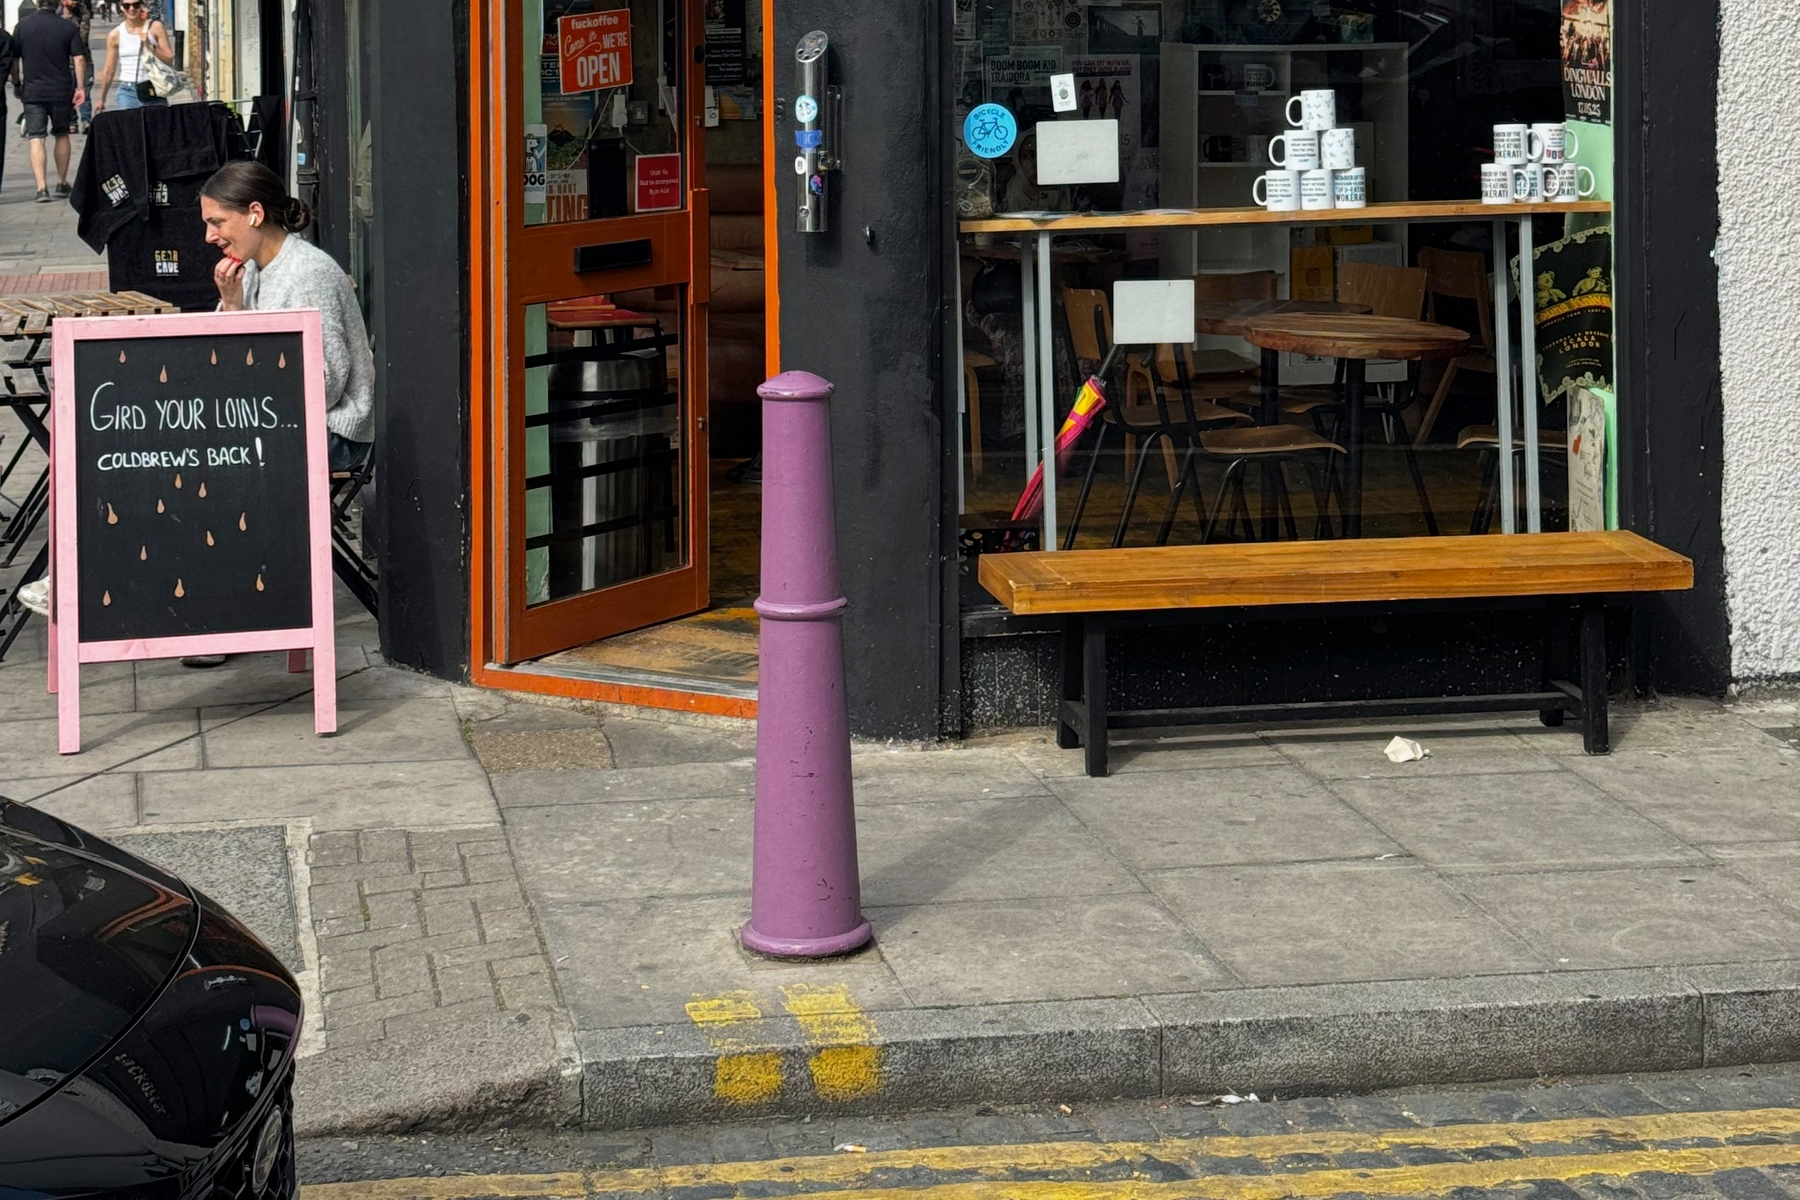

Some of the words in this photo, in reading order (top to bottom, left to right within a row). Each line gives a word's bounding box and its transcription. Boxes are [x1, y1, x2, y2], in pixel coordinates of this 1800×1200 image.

[571, 15, 619, 30] fuckoffee
[602, 32, 628, 49] WE'RE
[577, 51, 621, 88] OPEN
[991, 60, 1015, 71] BOOM
[1017, 60, 1041, 71] BOOM
[1042, 60, 1057, 70] KID
[1563, 67, 1611, 87] DINGWALLS
[1570, 82, 1606, 102] LONDON
[973, 108, 1006, 120] BICYCLE
[971, 140, 1009, 154] FRIENDLY
[523, 173, 545, 186] DOG
[557, 183, 577, 194] HART
[547, 194, 589, 223] TING
[154, 249, 179, 262] GEAR
[156, 262, 179, 273] CAVE
[1559, 341, 1601, 354] LONDON
[1562, 335, 1596, 347] SCALA
[90, 381, 146, 432] GIRD
[155, 397, 207, 431] YOUR
[216, 396, 298, 430] LOINS...
[97, 447, 200, 471] COLDBREW'S
